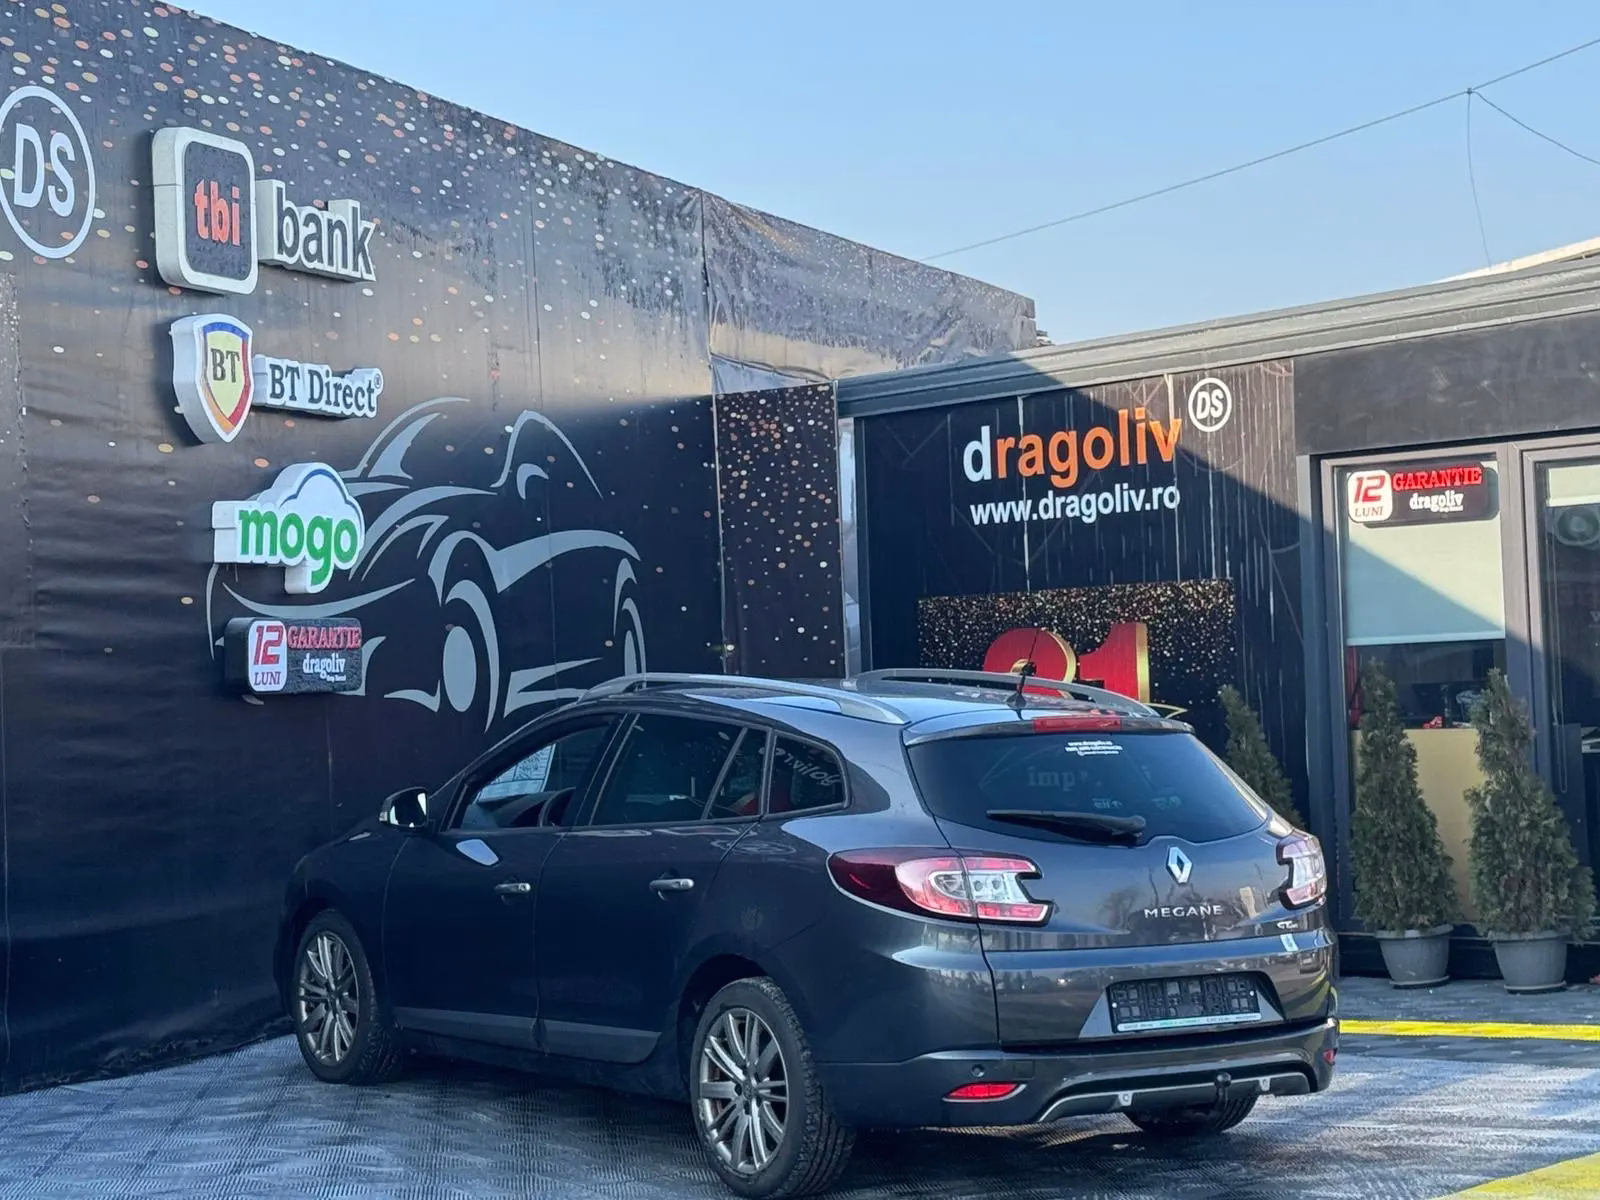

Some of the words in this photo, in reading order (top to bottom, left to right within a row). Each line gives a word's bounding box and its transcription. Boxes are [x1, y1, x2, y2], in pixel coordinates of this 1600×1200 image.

[13, 123, 76, 217] DS
[194, 179, 240, 247] tbi
[276, 181, 375, 281] bank
[210, 348, 240, 383] BT
[269, 363, 300, 403] BT
[1196, 389, 1225, 420] DS
[962, 406, 1183, 488] dragoliv
[1354, 475, 1386, 503] 12
[1392, 467, 1482, 491] GARANTIE
[970, 482, 1181, 524] www.dragoliv.ro
[1355, 506, 1384, 517] LUNI
[1409, 490, 1464, 512] dragoliv
[239, 509, 358, 586] mogo
[253, 624, 284, 666] 12
[286, 625, 361, 649] GARANTIE
[254, 671, 281, 686] LUNI
[302, 652, 346, 679] dragoliv
[1143, 904, 1224, 919] MEGANE
